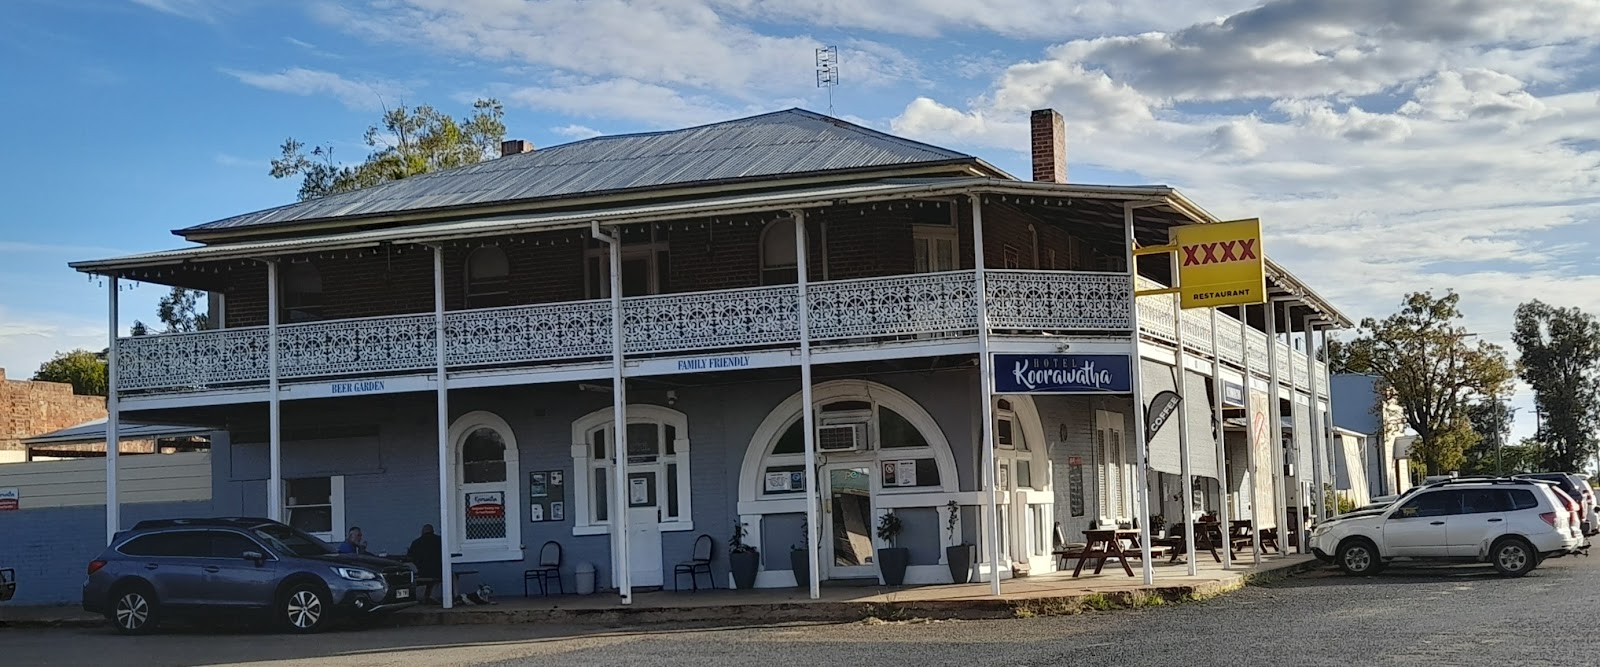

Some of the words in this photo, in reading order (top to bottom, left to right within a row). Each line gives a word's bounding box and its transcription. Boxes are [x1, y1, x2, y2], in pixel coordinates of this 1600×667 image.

[1182, 239, 1256, 267] XXXX
[1193, 289, 1250, 300] RESTAURANT
[678, 358, 706, 370] FAMILY
[709, 356, 750, 368] FRIENDLY
[1033, 358, 1077, 368] HOTEL
[1012, 359, 1112, 389] Koorawatha
[331, 383, 352, 394] BEER
[354, 380, 385, 392] GARDEN
[1151, 397, 1179, 431] COFFEE
